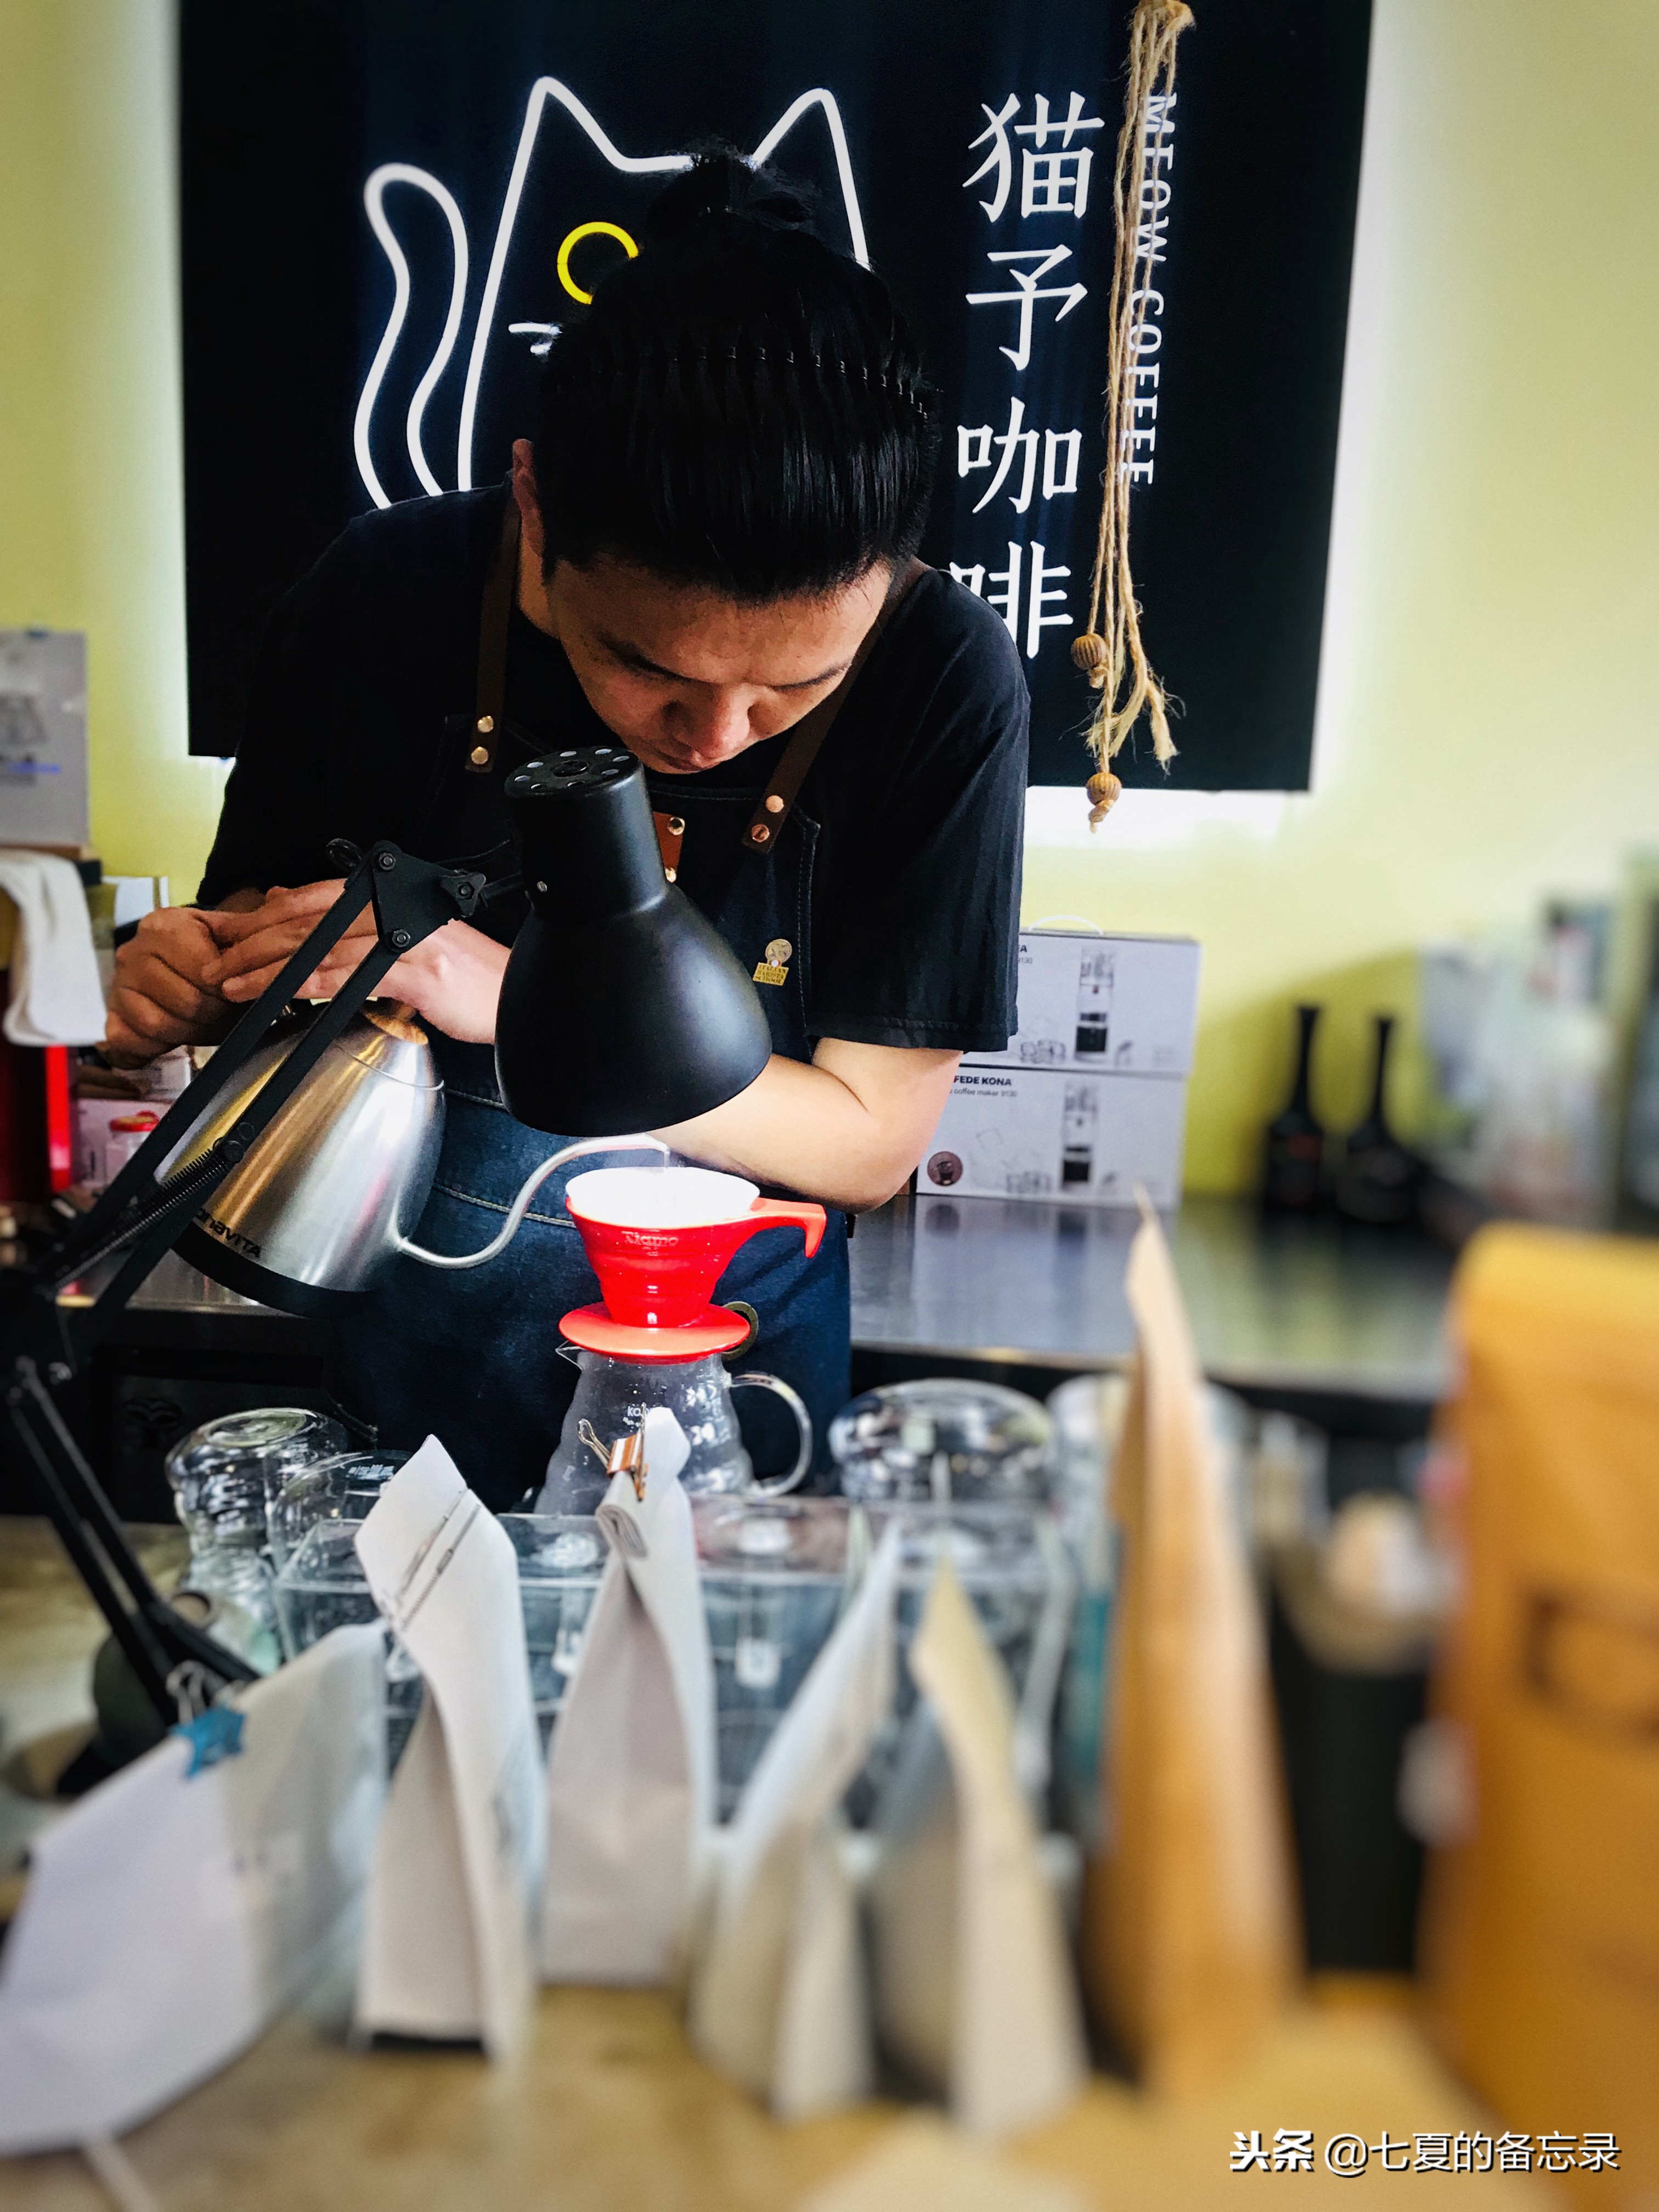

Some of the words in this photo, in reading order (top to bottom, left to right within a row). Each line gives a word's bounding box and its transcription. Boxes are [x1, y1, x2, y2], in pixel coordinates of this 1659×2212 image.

[950, 91, 1104, 658] 猫予咖啡
[1120, 289, 1164, 484] COFFEE
[981, 1076, 1012, 1086] KONA
